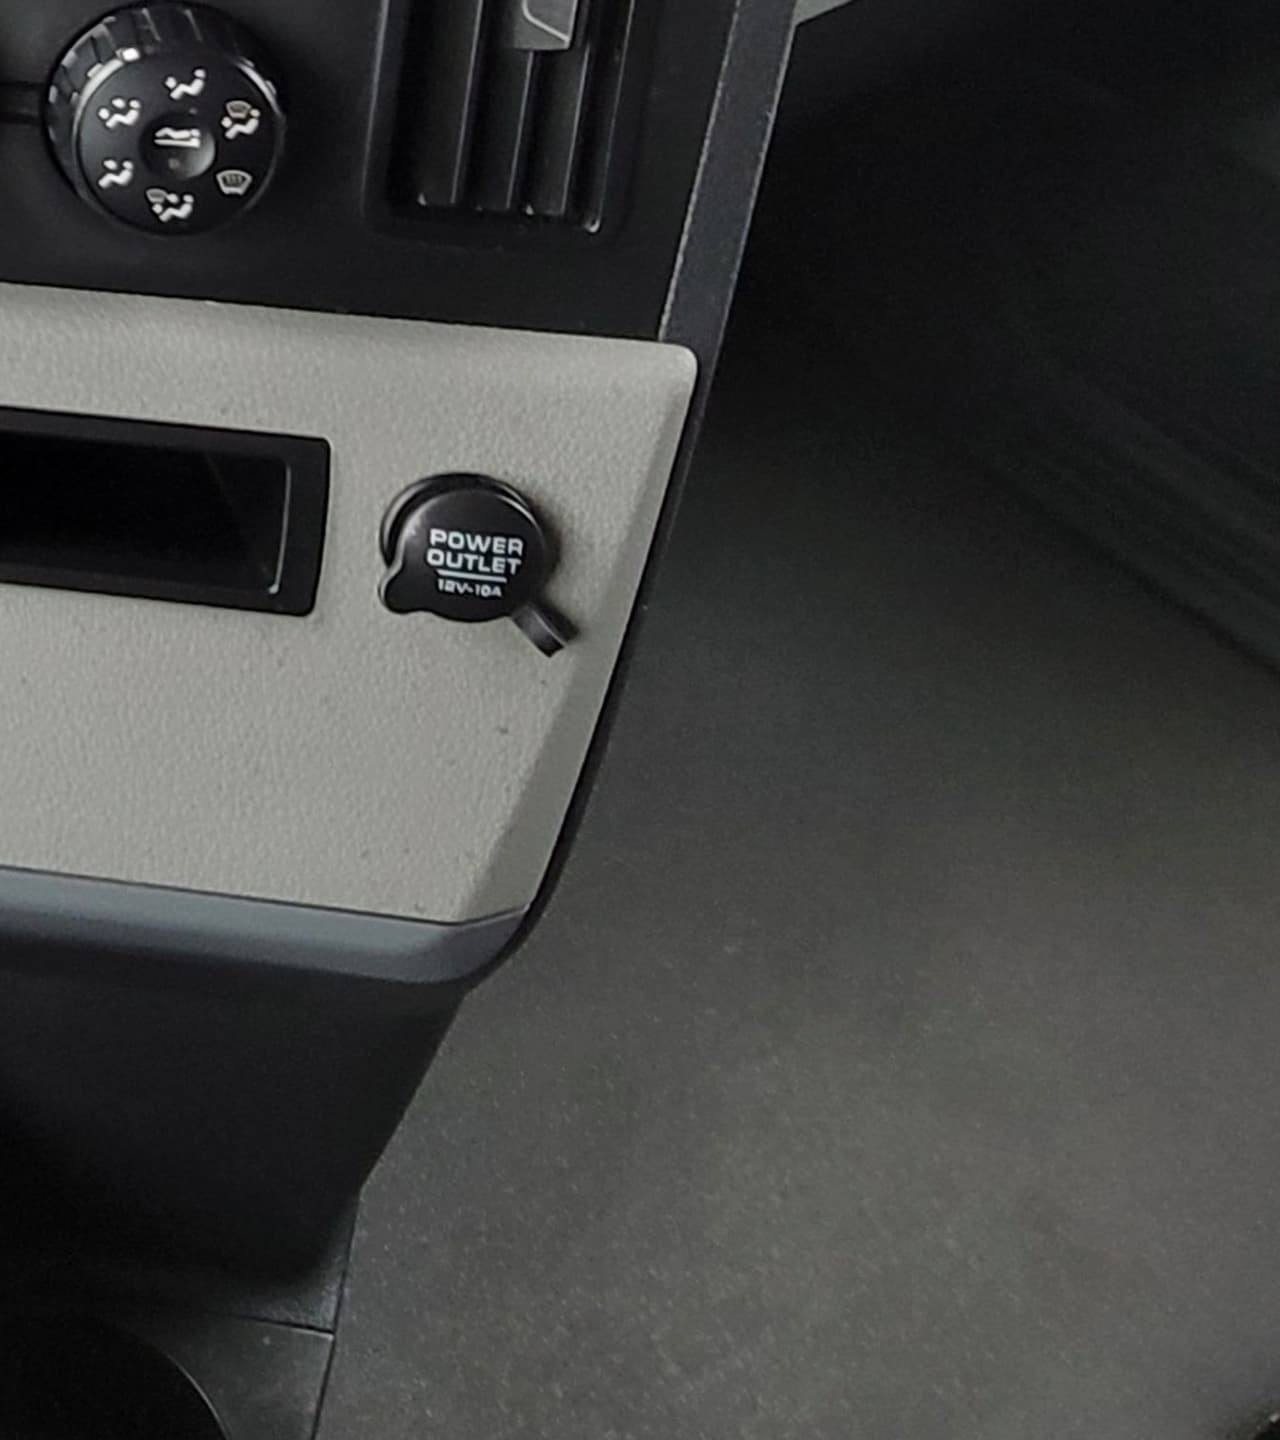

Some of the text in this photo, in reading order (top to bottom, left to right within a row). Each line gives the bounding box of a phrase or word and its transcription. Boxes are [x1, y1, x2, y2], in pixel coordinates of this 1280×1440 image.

[429, 527, 524, 557] POWER
[426, 548, 522, 575] OUTLET
[437, 578, 503, 598] 12V-10A
